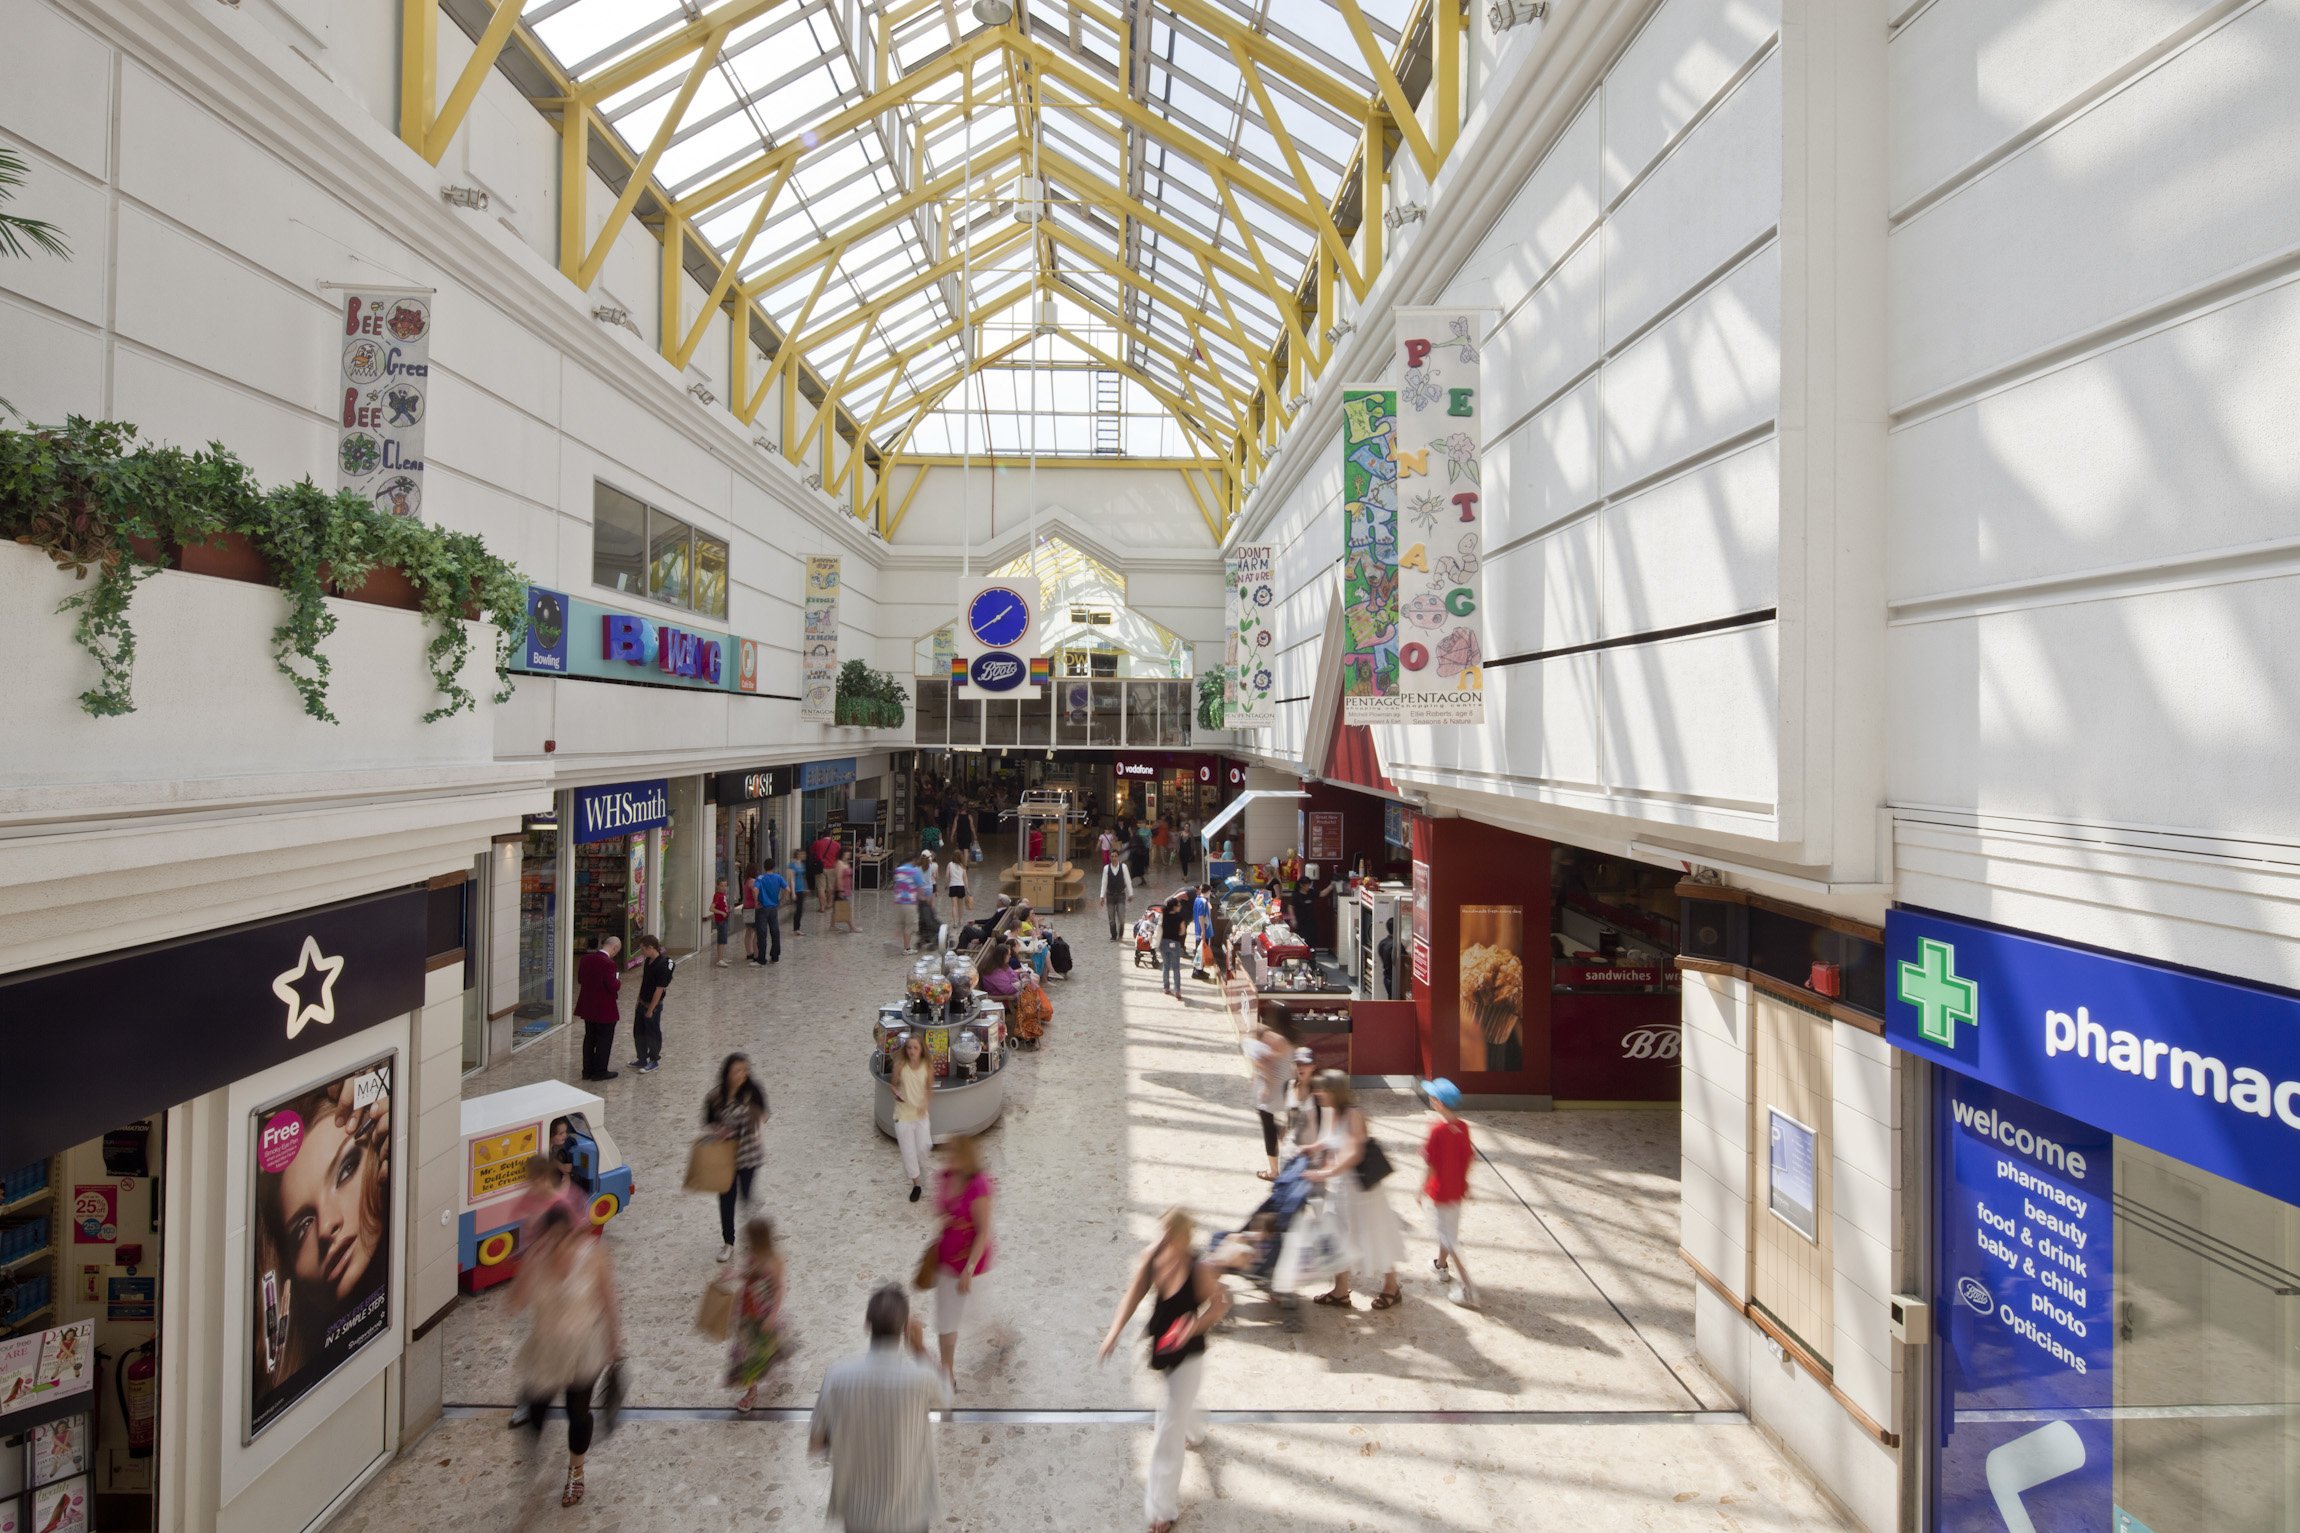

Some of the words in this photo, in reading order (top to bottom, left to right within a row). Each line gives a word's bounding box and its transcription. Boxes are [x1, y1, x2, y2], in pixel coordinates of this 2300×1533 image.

[1238, 558, 1268, 571] HARM
[1239, 547, 1271, 559] DON'T
[533, 652, 560, 670] Bowling
[978, 661, 1017, 681] Boots
[1346, 698, 1400, 706] PENTAGO
[1401, 692, 1482, 703] PENTAGON
[1125, 763, 1154, 775] vodafone
[585, 788, 666, 832] WHSmith
[1585, 970, 1651, 981] sandwiches
[1620, 1029, 1682, 1059] BB
[357, 1067, 390, 1101] MAX
[263, 1121, 299, 1149] Free
[1952, 1099, 2087, 1179] welcome
[1997, 1160, 2087, 1219] pharmacy
[1977, 1202, 2015, 1238] food
[2020, 1227, 2033, 1248] &
[2038, 1238, 2087, 1278] drink
[2024, 1198, 2087, 1250] beauty
[1977, 1228, 2018, 1269] baby
[2023, 1257, 2036, 1278] &
[2041, 1271, 2086, 1308] child
[324, 1333, 334, 1348] IN
[335, 1328, 340, 1340] 2
[342, 1308, 367, 1335] SIMPLE
[367, 1292, 385, 1315] STEPS
[2031, 1293, 2087, 1337] photo
[2000, 1304, 2087, 1375] Opticians
